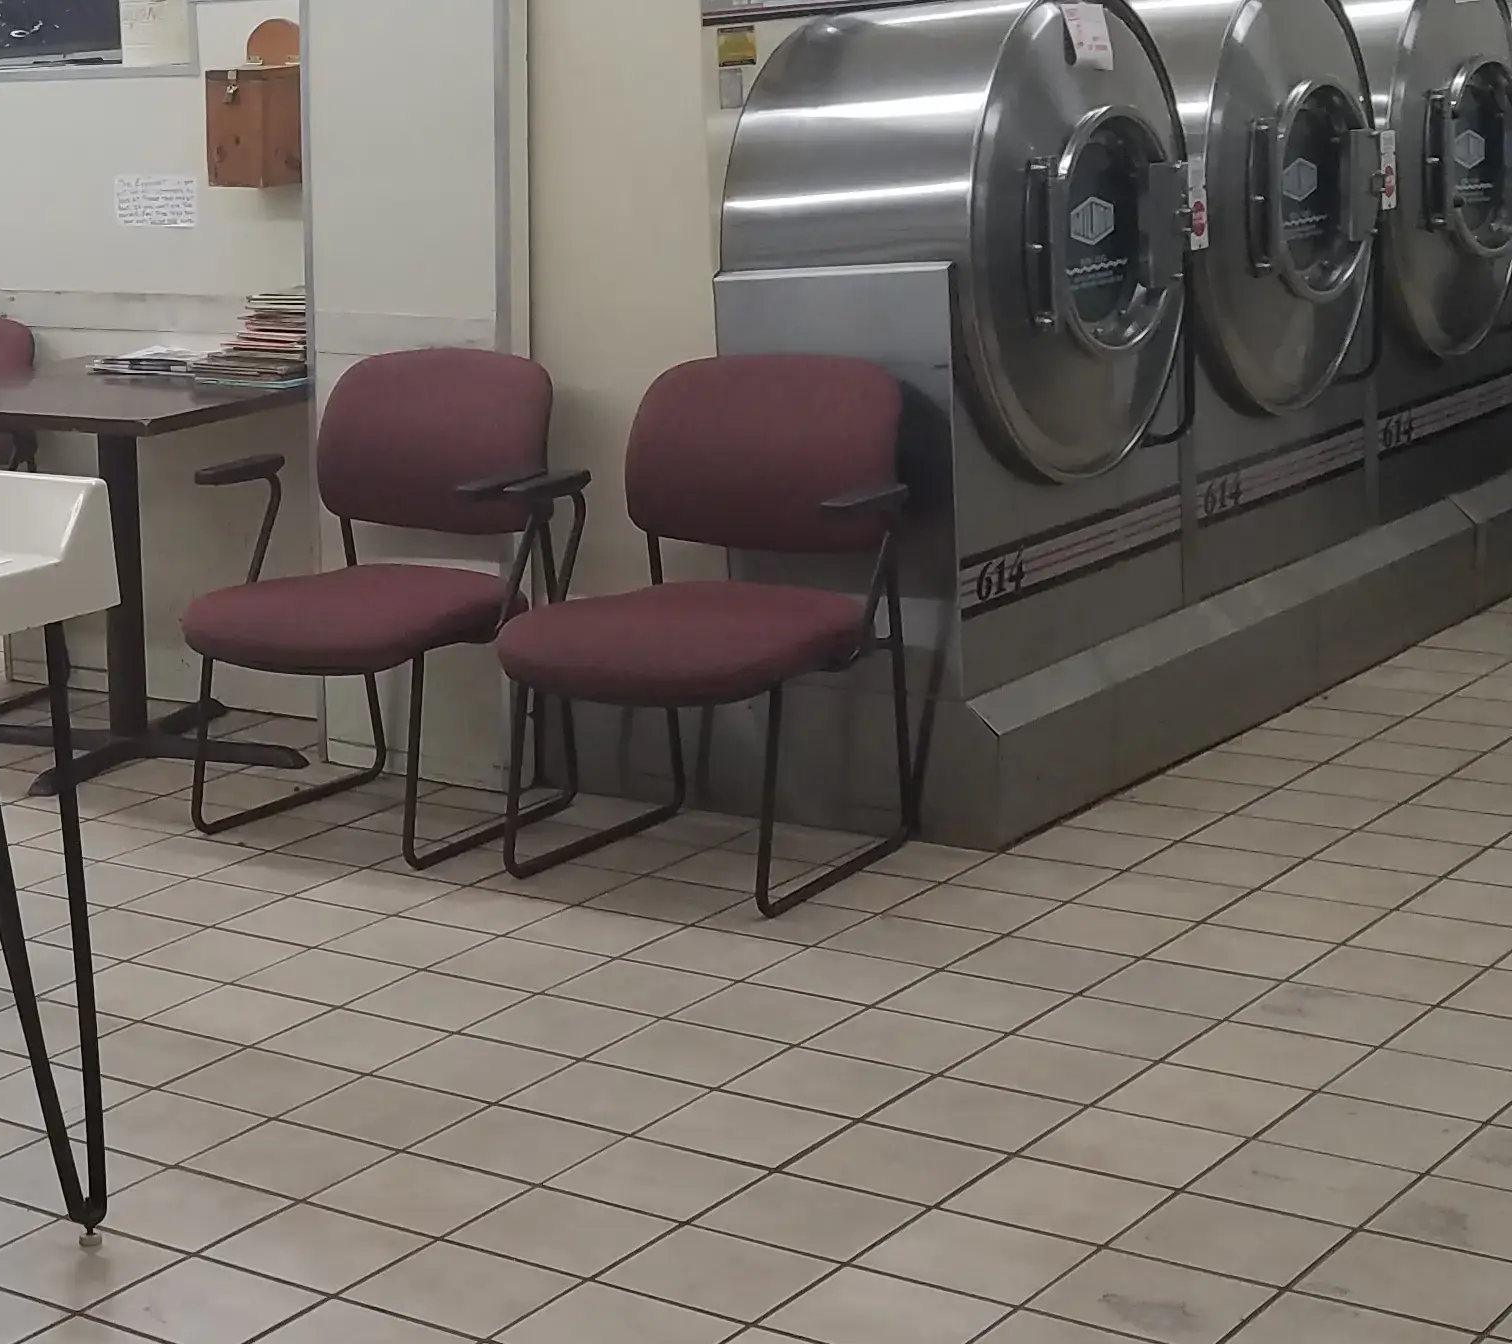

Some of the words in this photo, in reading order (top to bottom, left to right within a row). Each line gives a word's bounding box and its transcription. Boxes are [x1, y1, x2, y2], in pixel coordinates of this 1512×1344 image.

[1382, 412, 1416, 450] 614
[1202, 469, 1244, 516] 614
[975, 548, 1026, 601] 614
